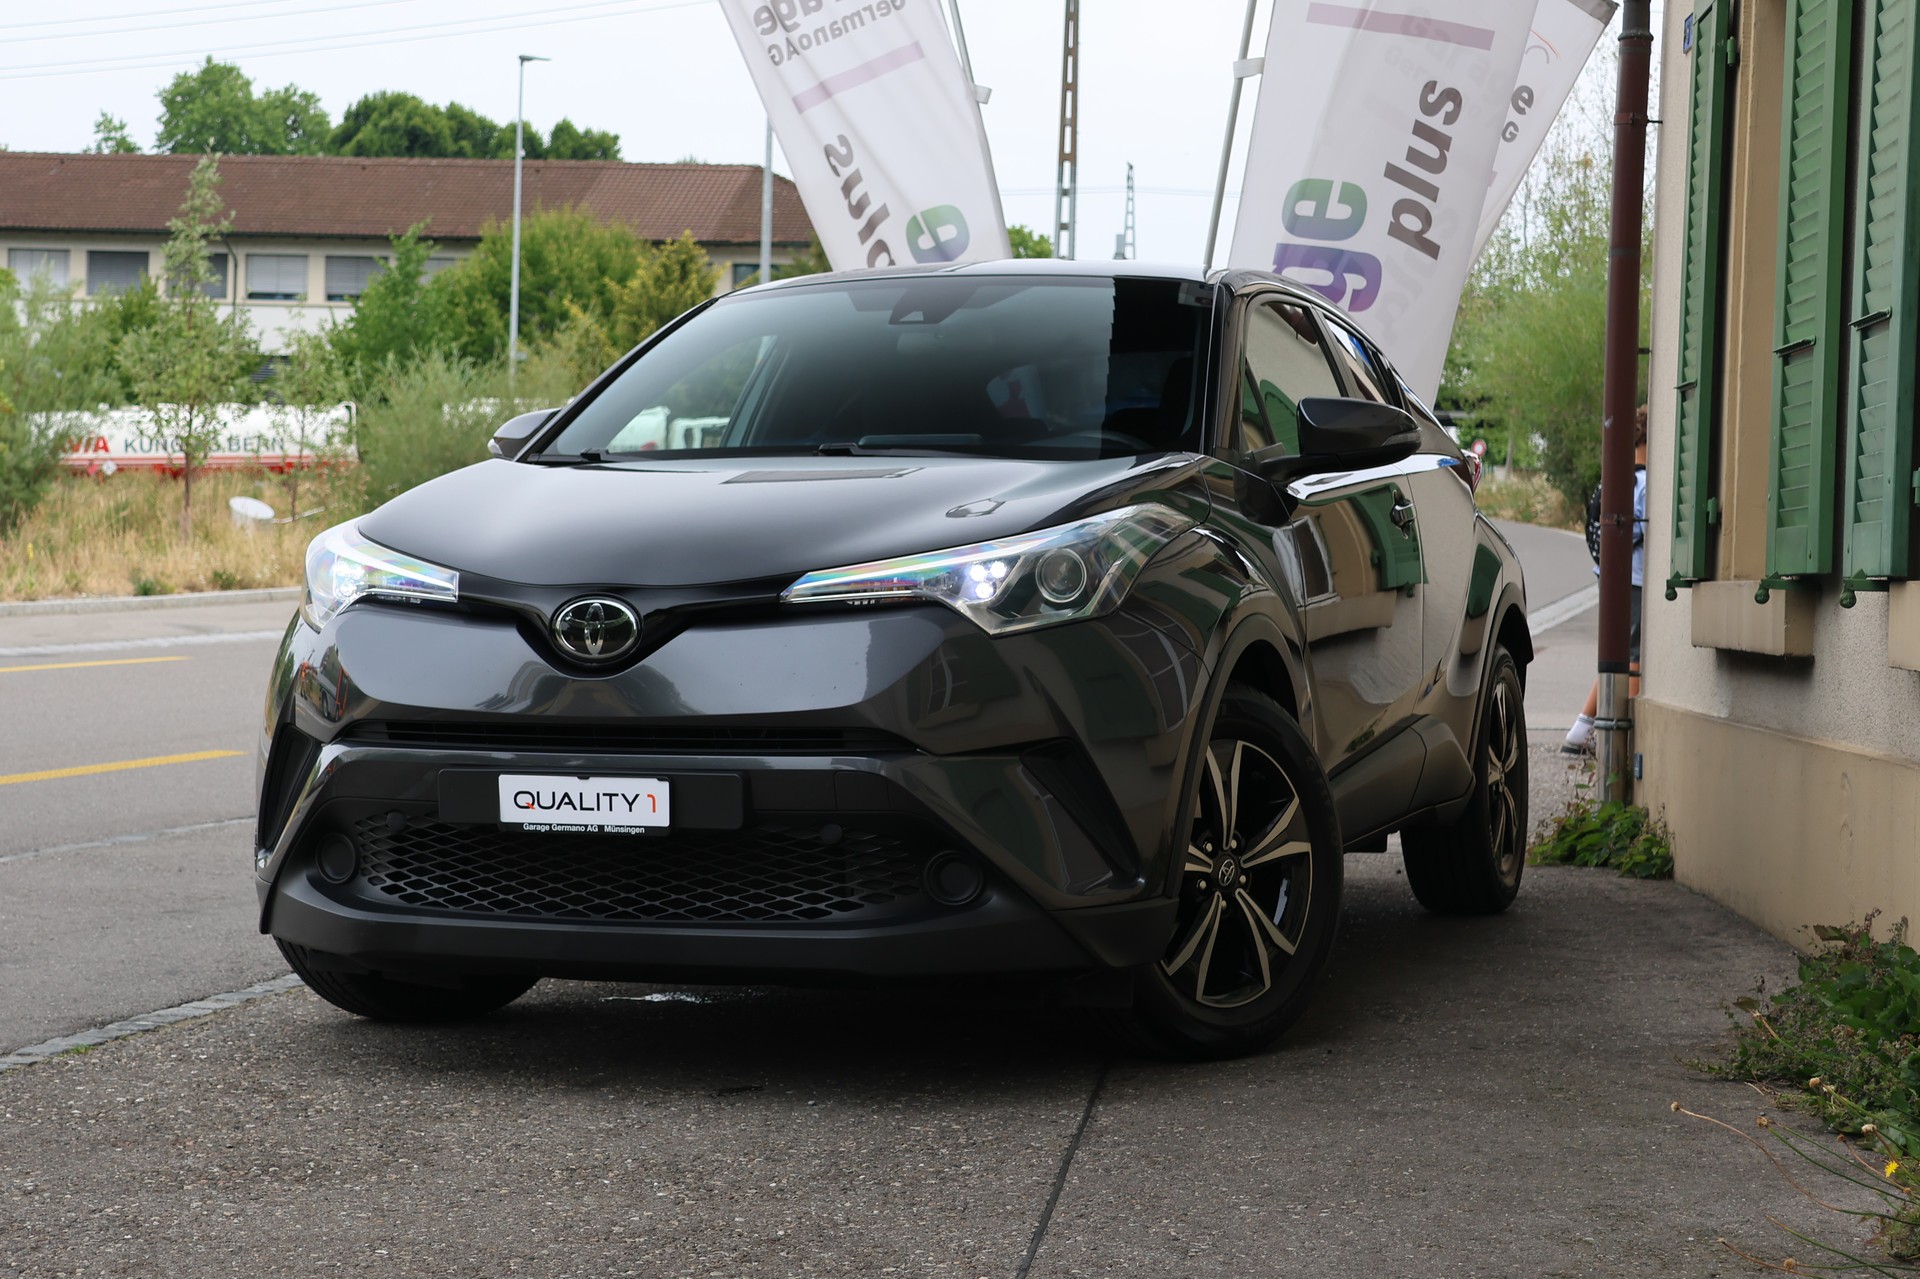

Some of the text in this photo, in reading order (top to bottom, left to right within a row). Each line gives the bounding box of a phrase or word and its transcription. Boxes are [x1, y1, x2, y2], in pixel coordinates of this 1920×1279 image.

[1383, 80, 1463, 261] plus
[513, 790, 640, 813] QUALITY
[523, 822, 645, 835] Garage Germano AG Münsingen
